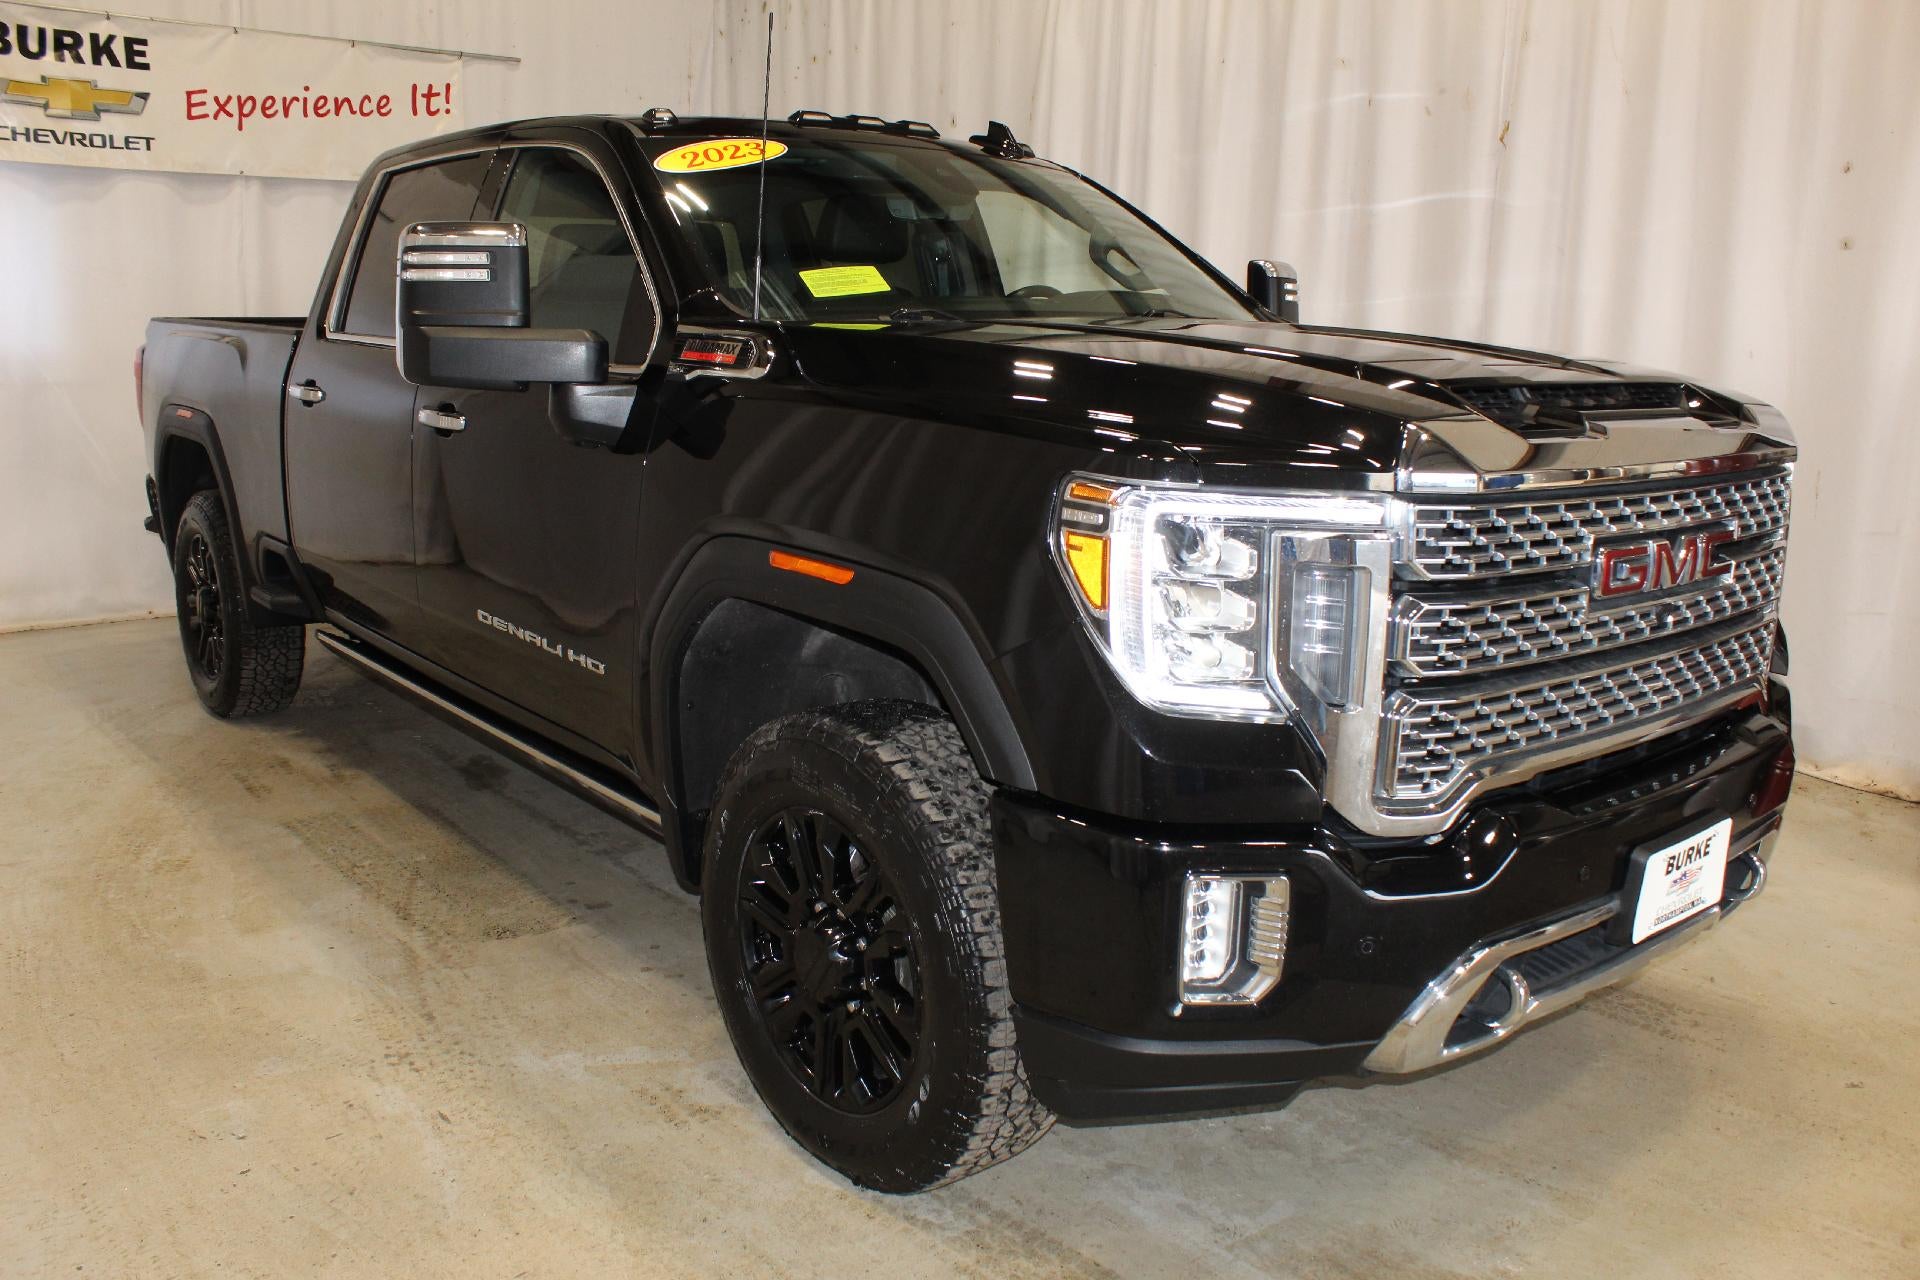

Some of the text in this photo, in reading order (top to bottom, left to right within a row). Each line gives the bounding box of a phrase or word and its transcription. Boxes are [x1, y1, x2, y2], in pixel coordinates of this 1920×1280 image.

[185, 82, 452, 131] Experience It!
[0, 125, 156, 151] CHEVROLET
[680, 142, 766, 169] 2023
[1597, 523, 1736, 599] GMC
[476, 609, 606, 675] DENALI HD
[1664, 836, 1712, 877] BURKE
